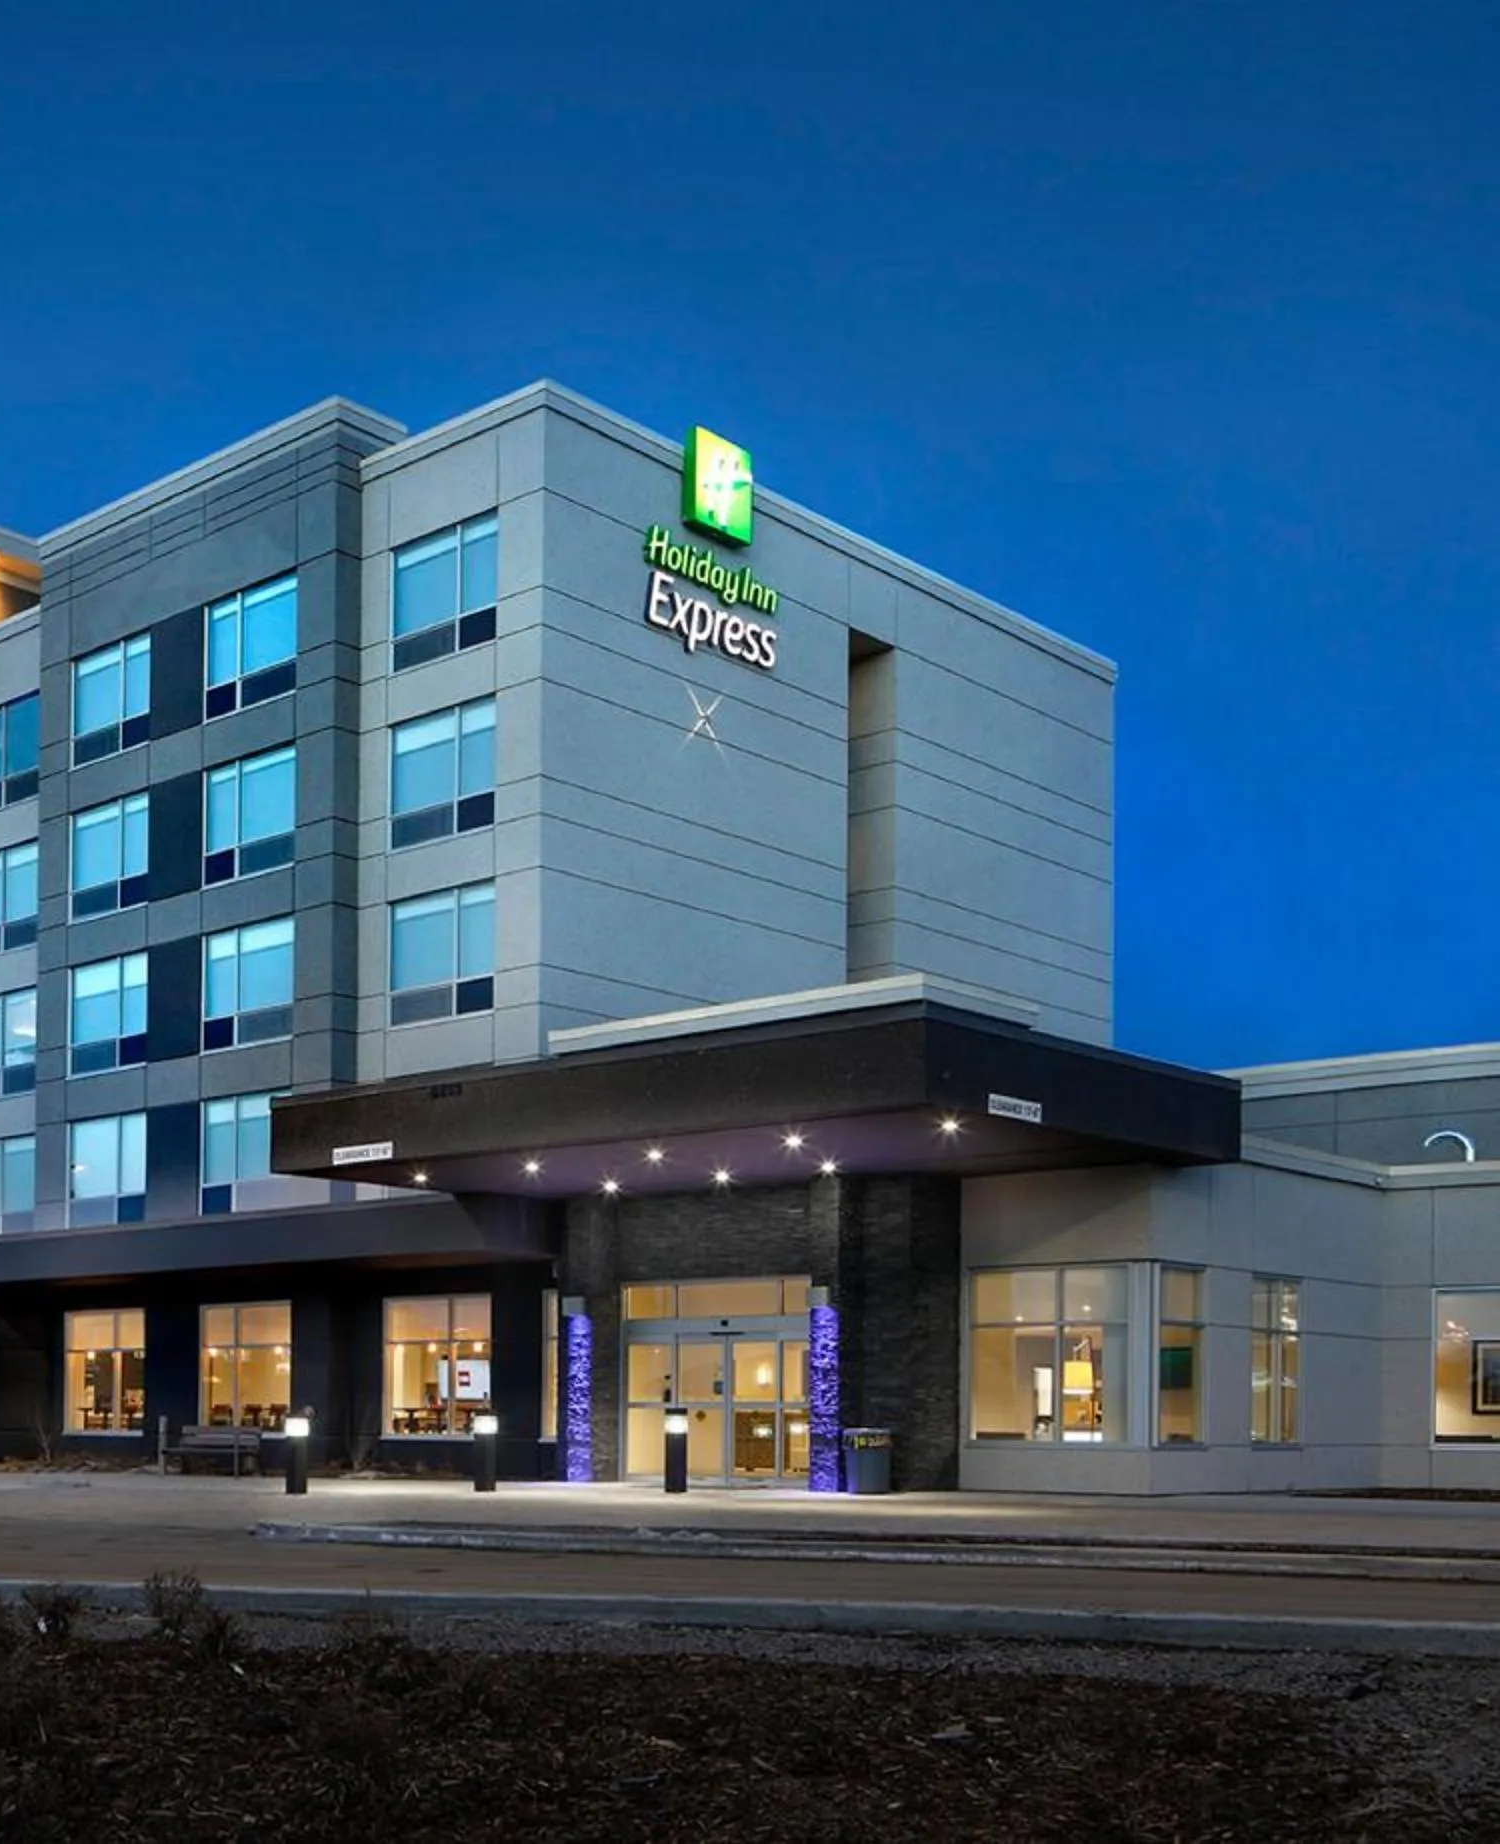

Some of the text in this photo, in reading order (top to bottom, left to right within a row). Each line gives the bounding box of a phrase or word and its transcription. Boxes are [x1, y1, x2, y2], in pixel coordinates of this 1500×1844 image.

[648, 524, 778, 612] Holiday Inn
[648, 570, 778, 669] Express
